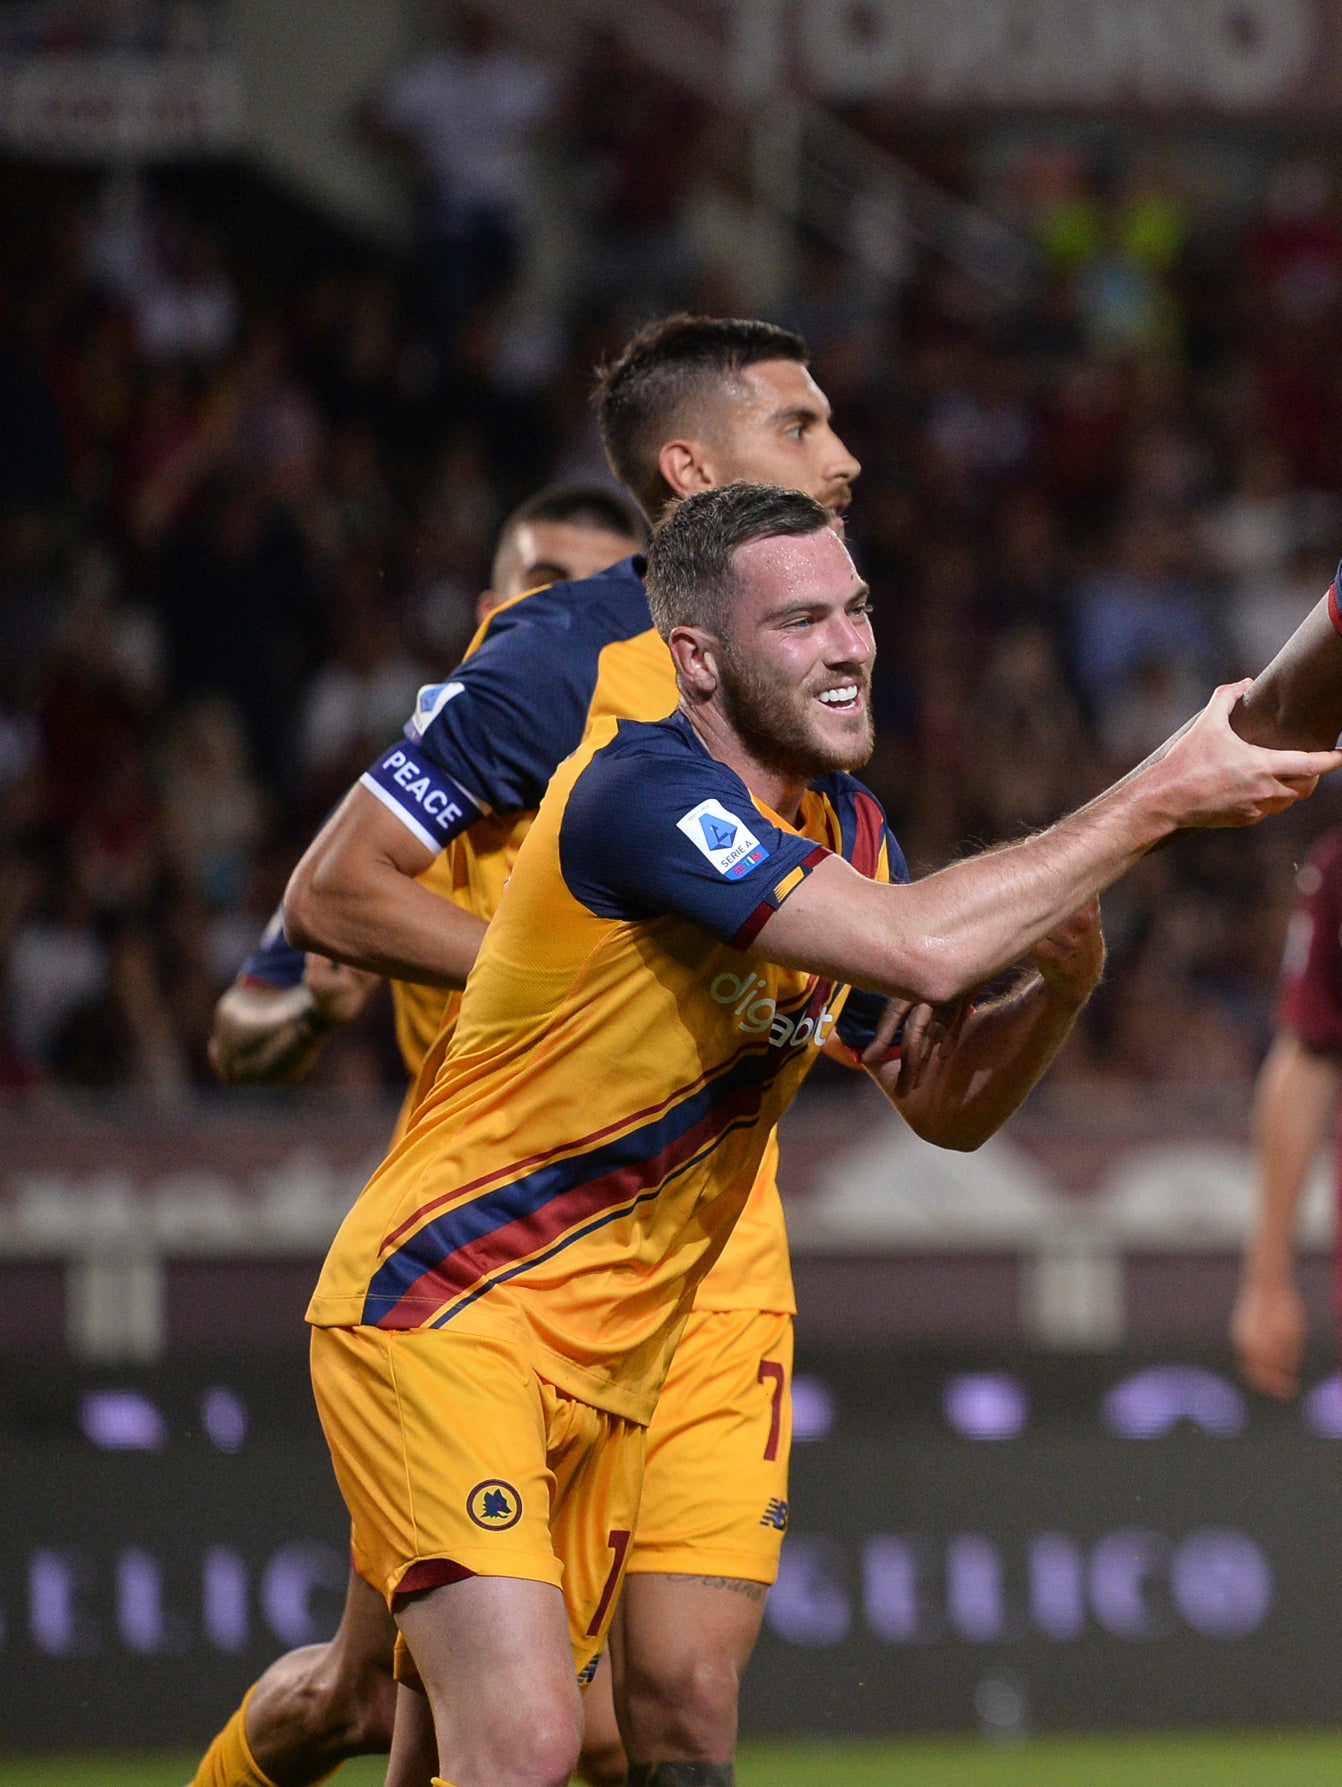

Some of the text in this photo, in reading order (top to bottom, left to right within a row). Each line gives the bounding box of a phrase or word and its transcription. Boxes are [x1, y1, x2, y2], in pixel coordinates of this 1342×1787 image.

[382, 750, 463, 830] PEACE
[720, 840, 753, 868] SERIE A
[757, 1359, 785, 1462] 7
